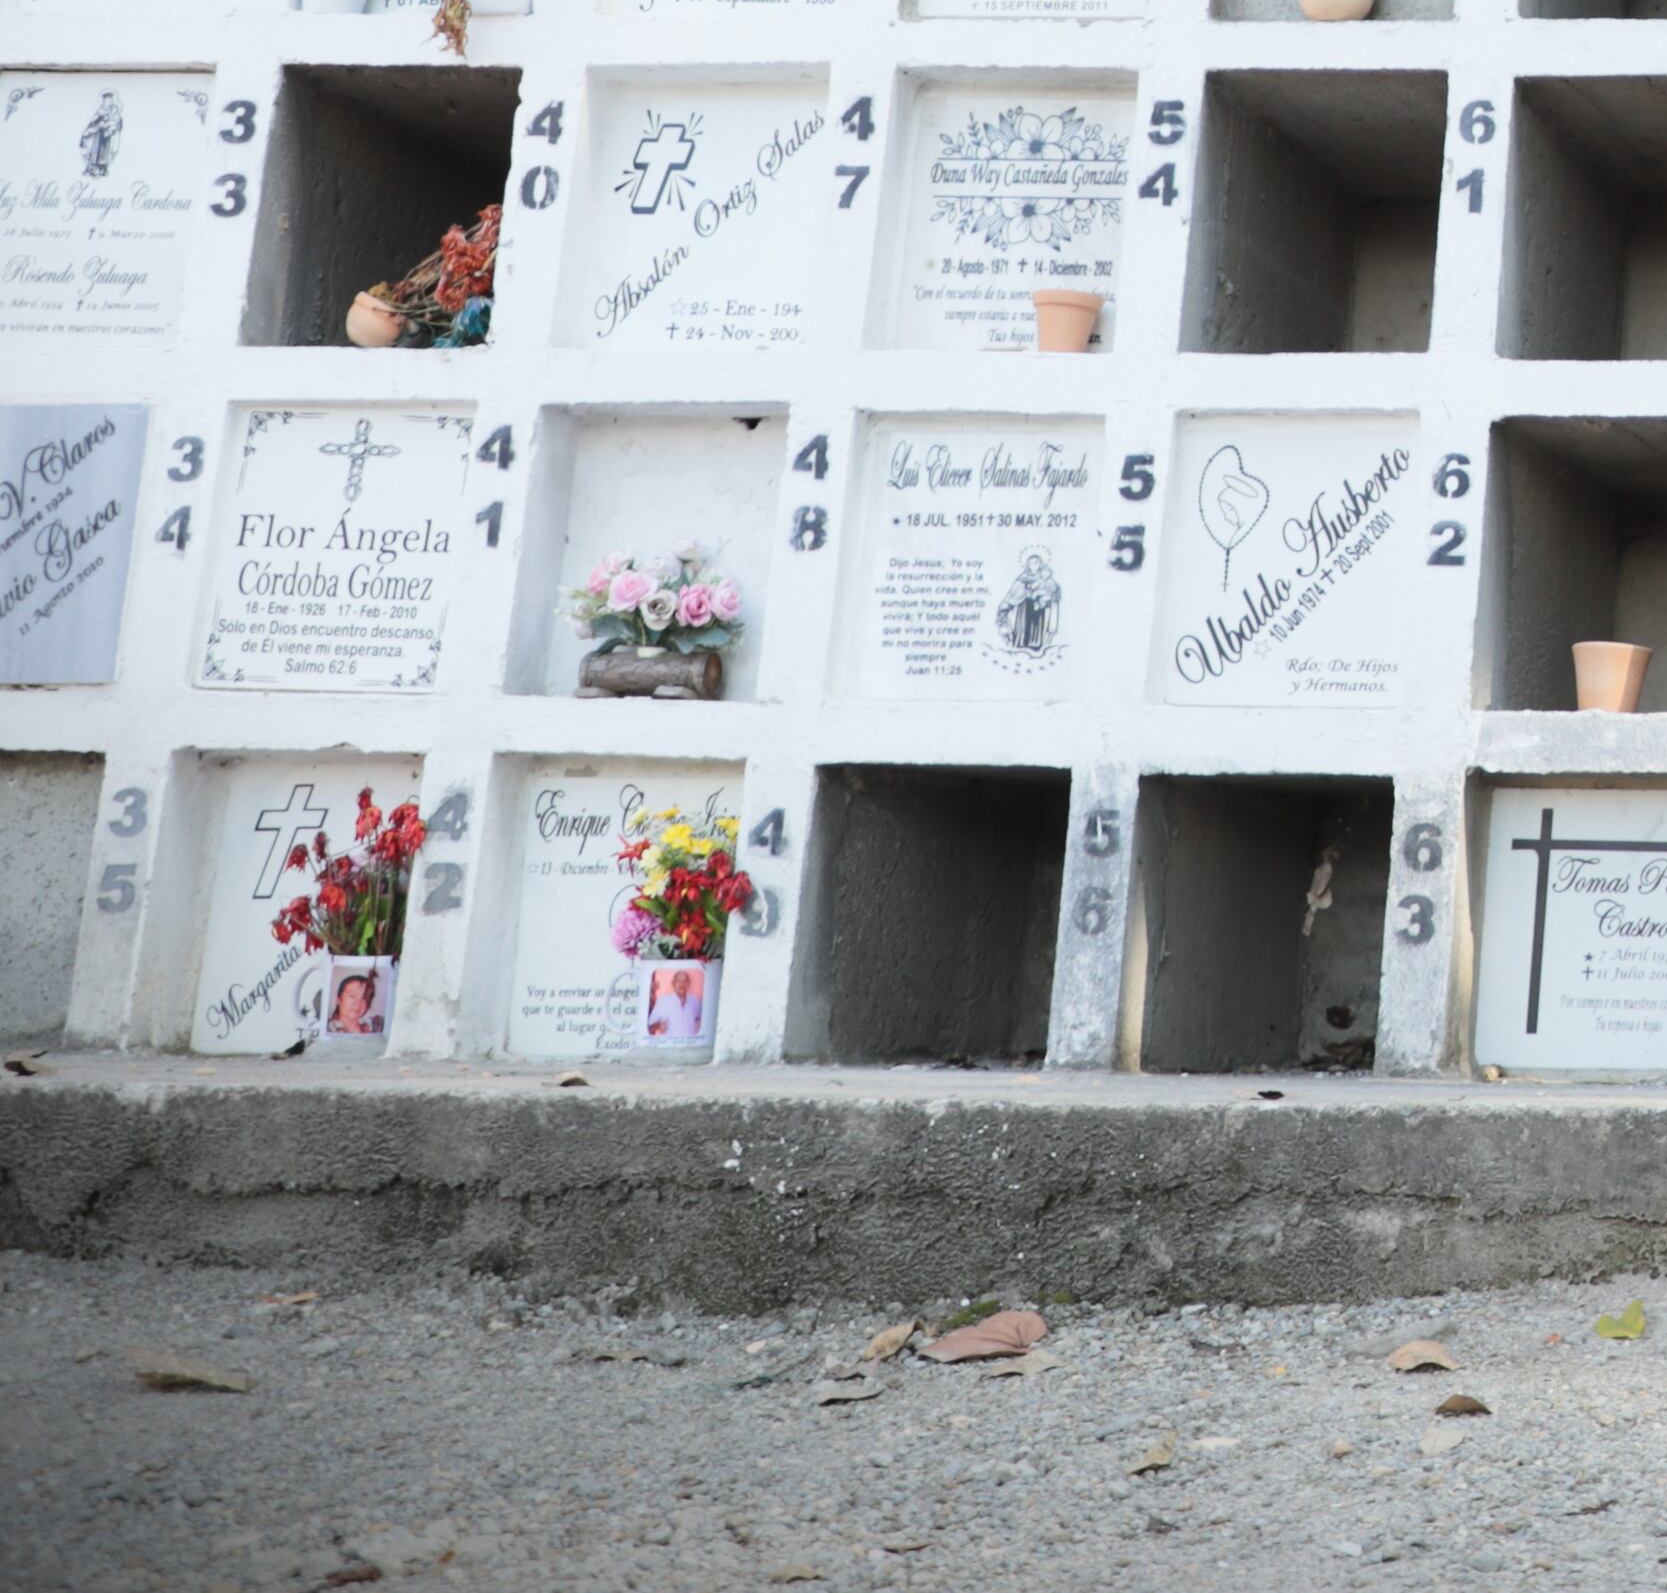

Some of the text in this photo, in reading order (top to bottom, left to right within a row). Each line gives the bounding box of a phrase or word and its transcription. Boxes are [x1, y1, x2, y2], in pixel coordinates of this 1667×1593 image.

[694, 179, 758, 237] Ortiz
[757, 111, 825, 180] Salas
[236, 507, 450, 565] Flor Ángela
[956, 514, 1078, 527] 1951 2012
[238, 560, 434, 601] Córdoba Gómez
[1176, 449, 1410, 683] Ubaldo Ausberto
[269, 620, 434, 640] Dios encuentro descanso
[535, 789, 611, 855] Enrique
[1552, 856, 1631, 894] Tomas
[208, 946, 302, 1040] Margarita
